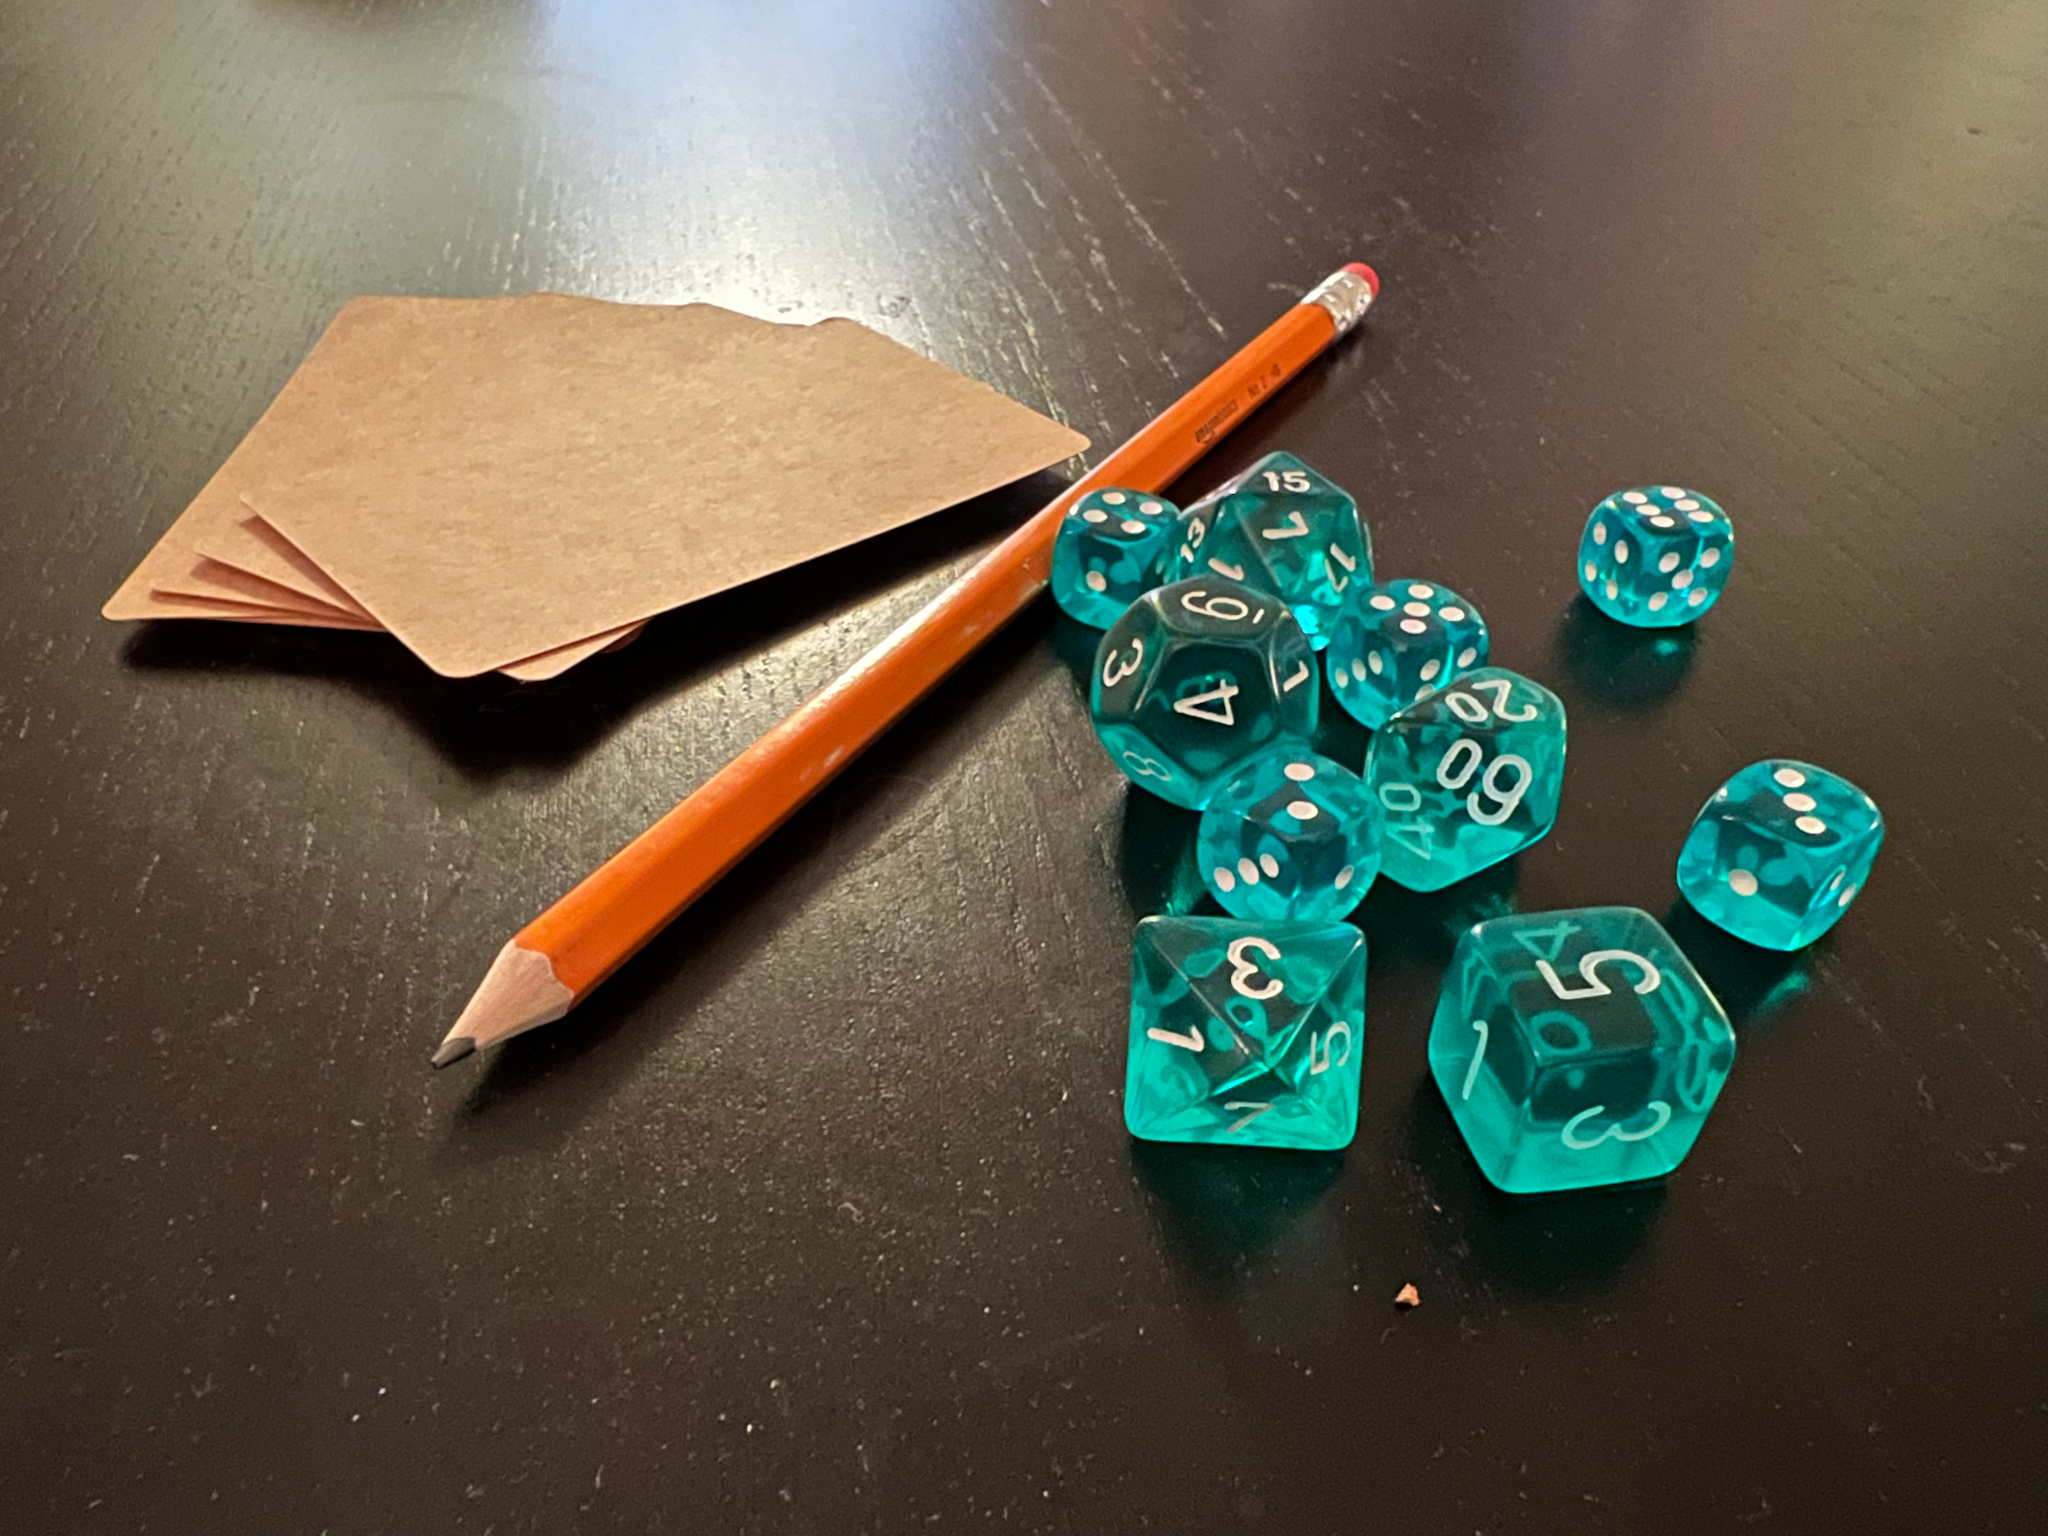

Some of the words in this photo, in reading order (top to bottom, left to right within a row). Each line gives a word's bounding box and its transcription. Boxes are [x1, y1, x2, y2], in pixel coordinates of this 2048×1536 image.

[1262, 471, 1311, 493] 15
[1102, 638, 1143, 687] 3
[1173, 678, 1239, 726] 4
[1444, 679, 1538, 722] 20
[1122, 750, 1172, 781] 8
[1226, 936, 1284, 1000] 3
[1535, 949, 1661, 1001] 5
[1310, 1021, 1352, 1075] 5
[1561, 1100, 1672, 1150] 3
